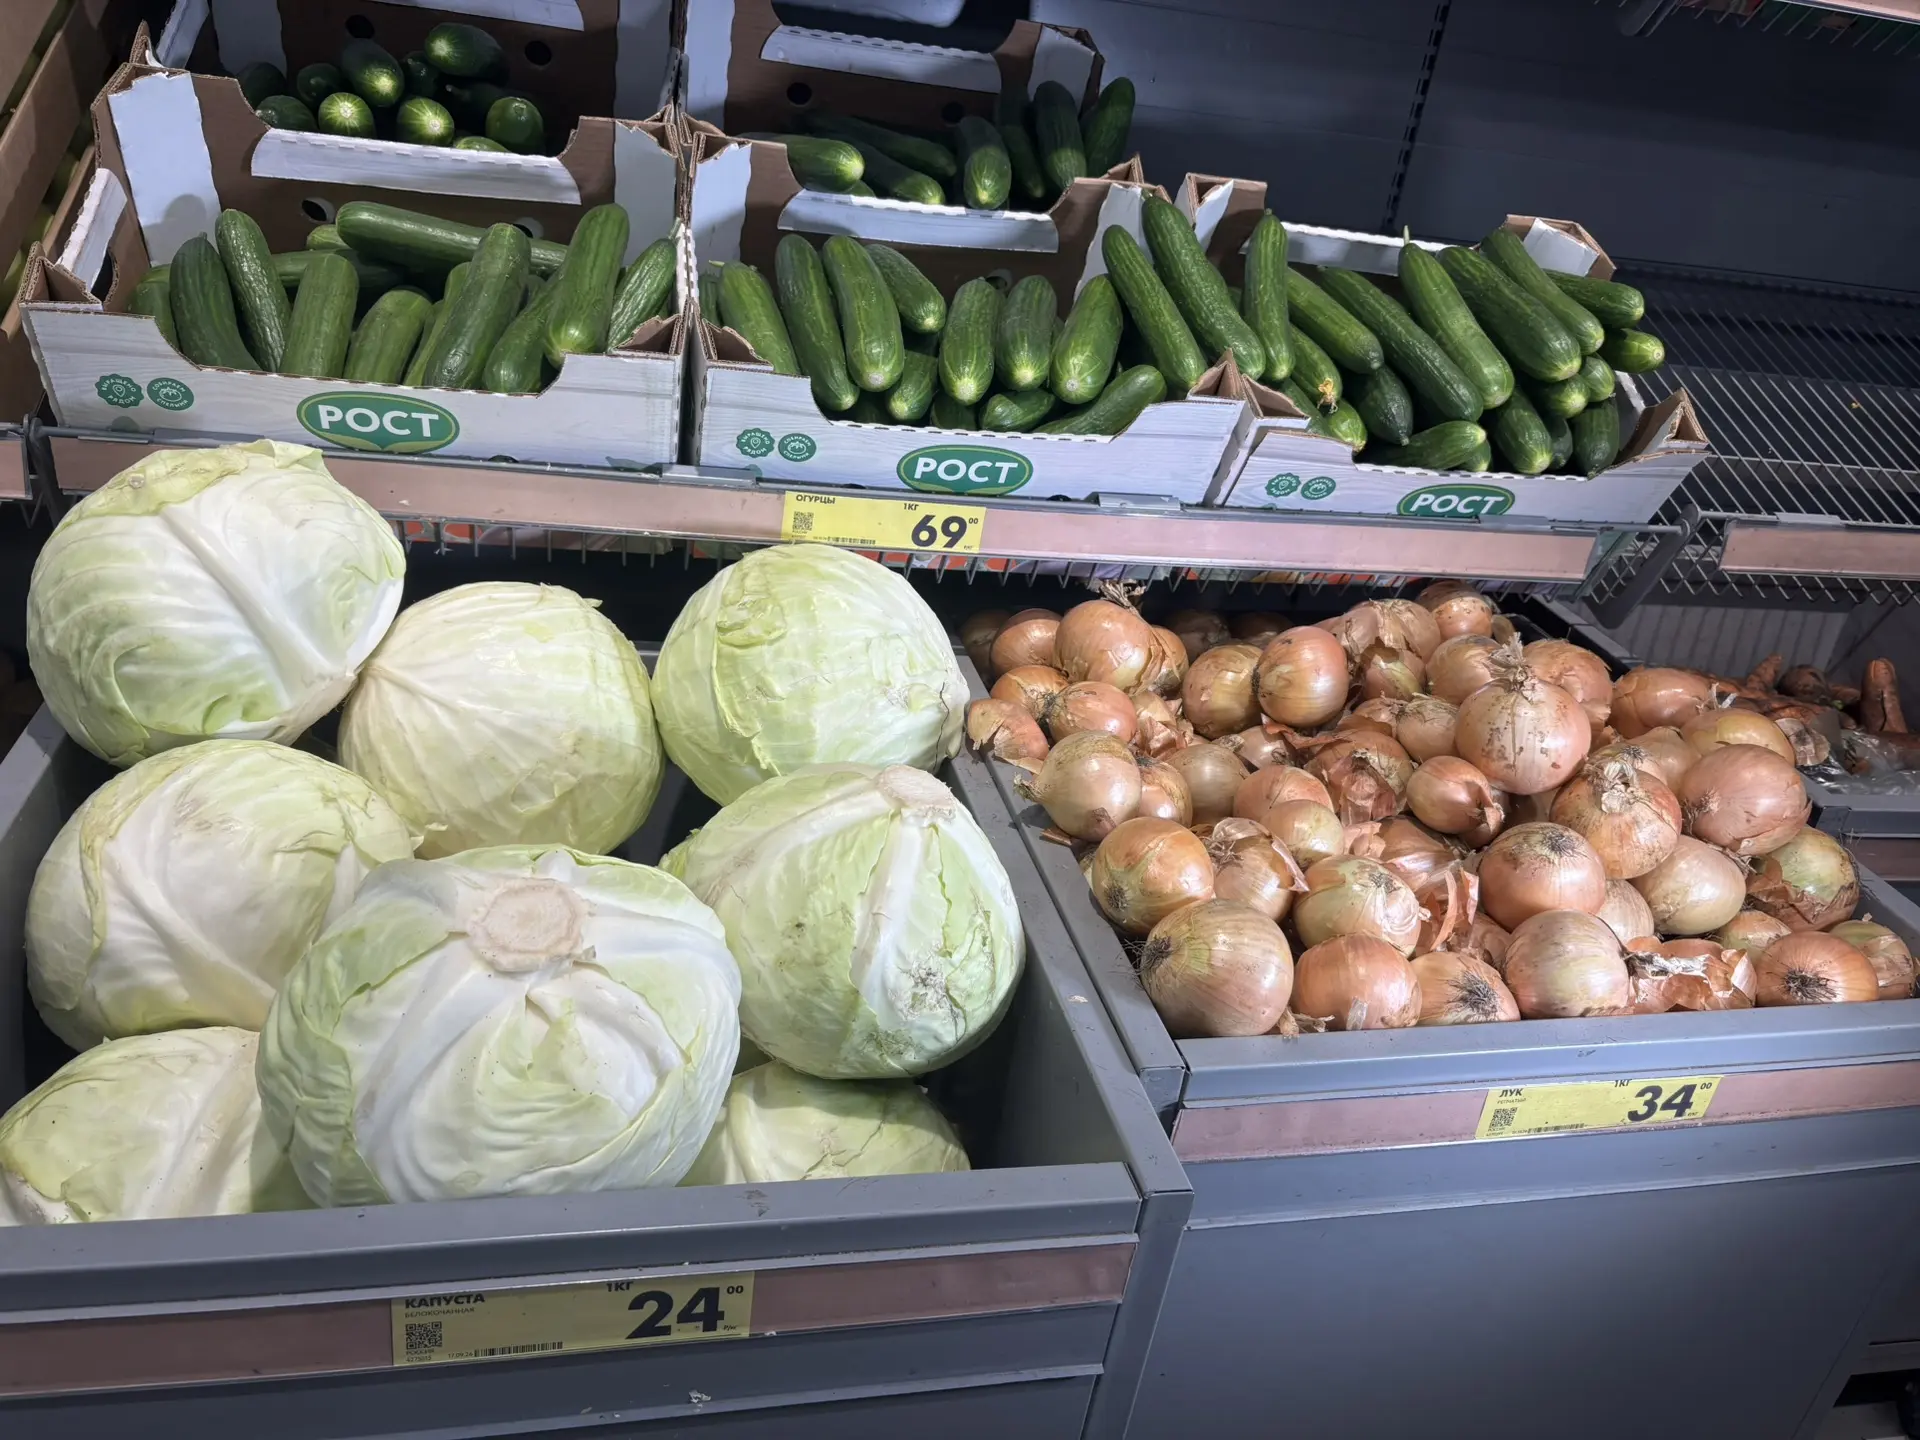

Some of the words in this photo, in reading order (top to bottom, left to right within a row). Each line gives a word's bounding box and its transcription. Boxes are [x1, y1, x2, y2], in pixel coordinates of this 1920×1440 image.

[317, 404, 440, 438] РОСТ
[913, 457, 1019, 484] РОСТ
[796, 494, 836, 505] ОГУРЦЫ
[1408, 493, 1505, 515] РОСТ
[911, 514, 968, 549] 69
[968, 517, 979, 525] 00
[1499, 1087, 1524, 1098] ЛУК
[1627, 1083, 1698, 1122] 34
[1699, 1082, 1713, 1090] 00
[404, 1293, 486, 1309] КАПУСТА
[404, 1307, 475, 1319] БЕЛОКОЧАННАЯ
[624, 1286, 725, 1340] 24
[726, 1285, 744, 1295] 00
